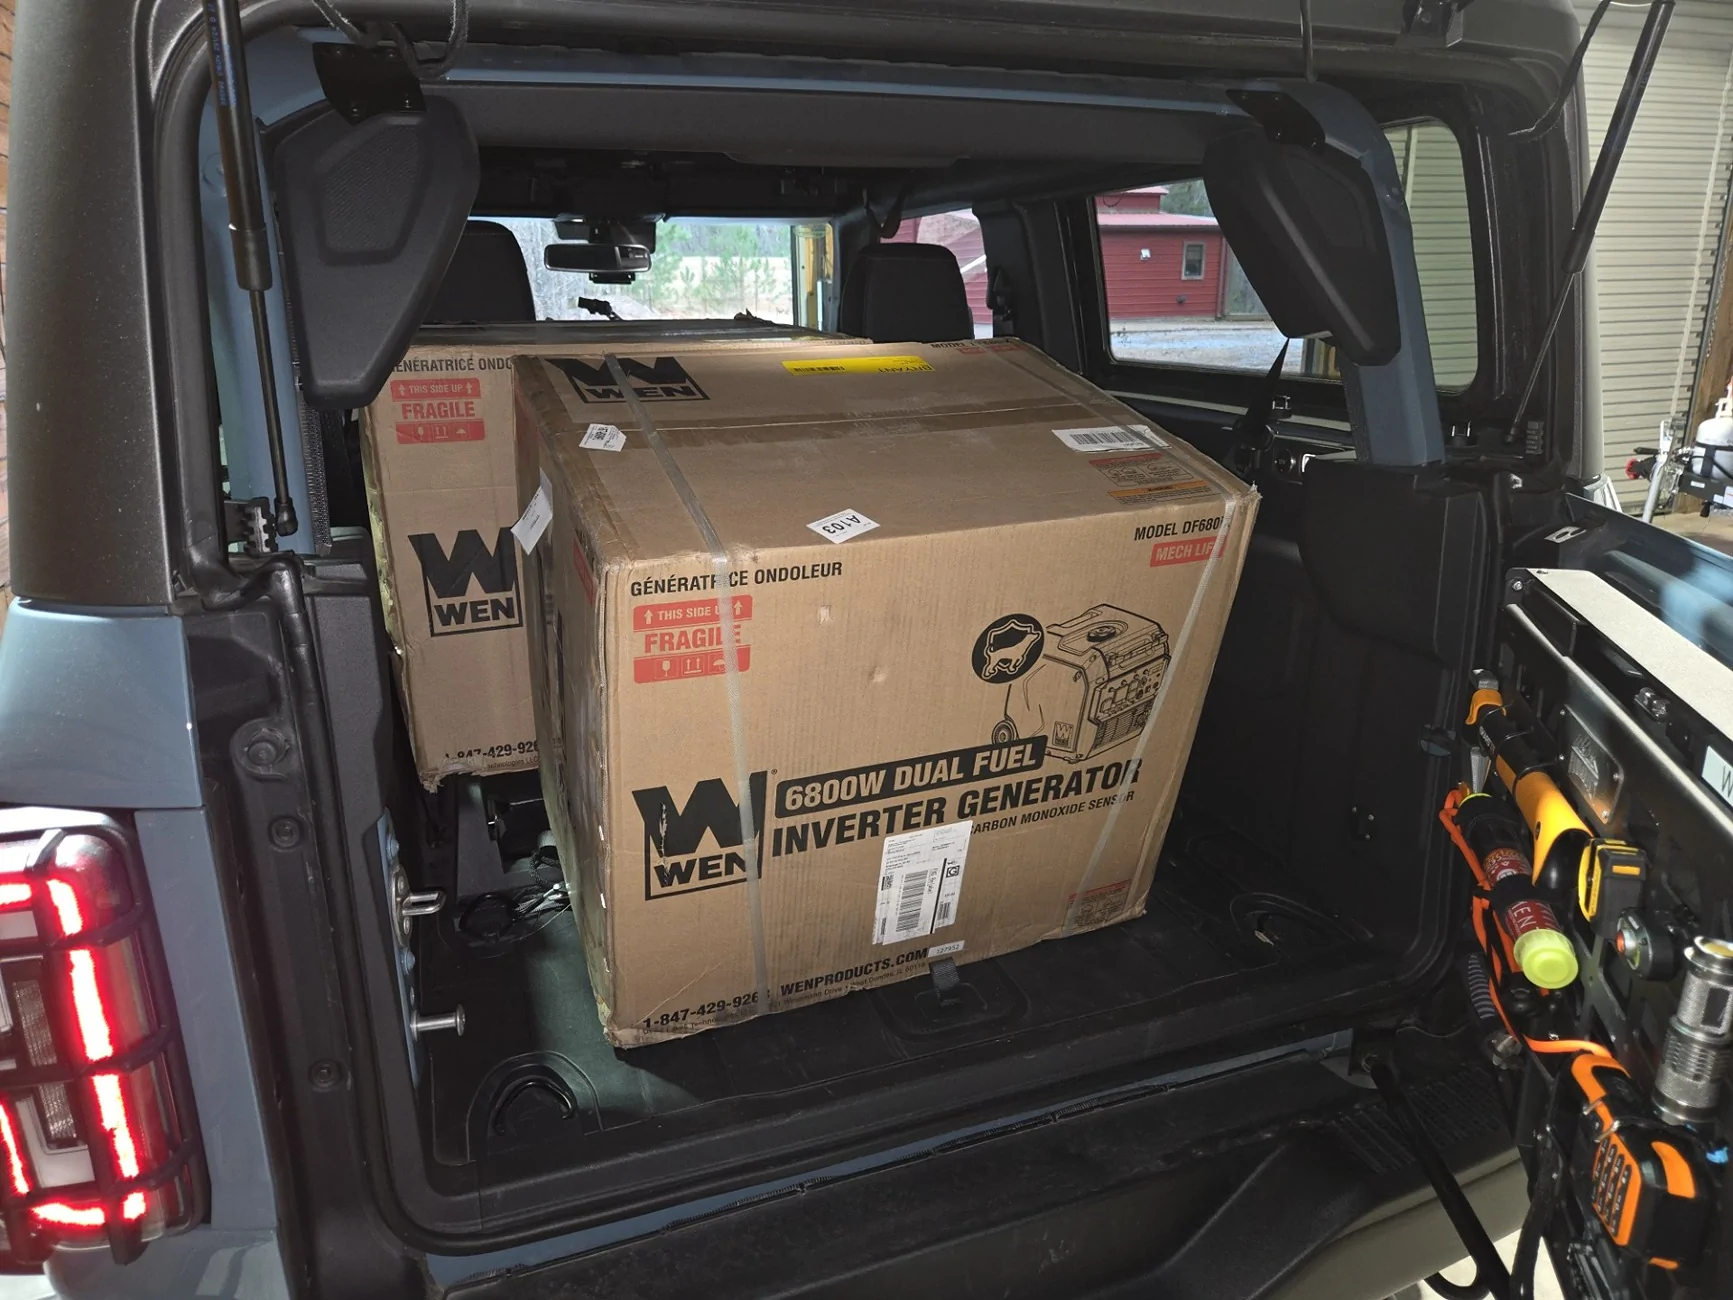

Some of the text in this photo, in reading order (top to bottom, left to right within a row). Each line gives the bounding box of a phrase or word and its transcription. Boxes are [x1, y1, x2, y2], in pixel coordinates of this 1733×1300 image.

[408, 383, 464, 394] THIS SIDE UP
[585, 385, 697, 399] WEN
[401, 401, 476, 419] FRAGILE
[822, 515, 861, 534] A103
[1134, 523, 1178, 541] MODEL
[1155, 541, 1214, 562] MECH LIF
[754, 561, 843, 585] ONDOLEUR
[434, 597, 516, 627] WEN
[657, 608, 683, 621] THIS
[686, 606, 711, 618] SIDE
[785, 743, 1036, 811] 6800W DUAL FUEL
[772, 796, 946, 857] INVERTER
[957, 757, 1143, 820] GENERATOR
[1021, 802, 1085, 823] MONOXIDE
[643, 990, 770, 1028] 1-847-429-926
[780, 947, 929, 997] WENPRODUCTS.COM
